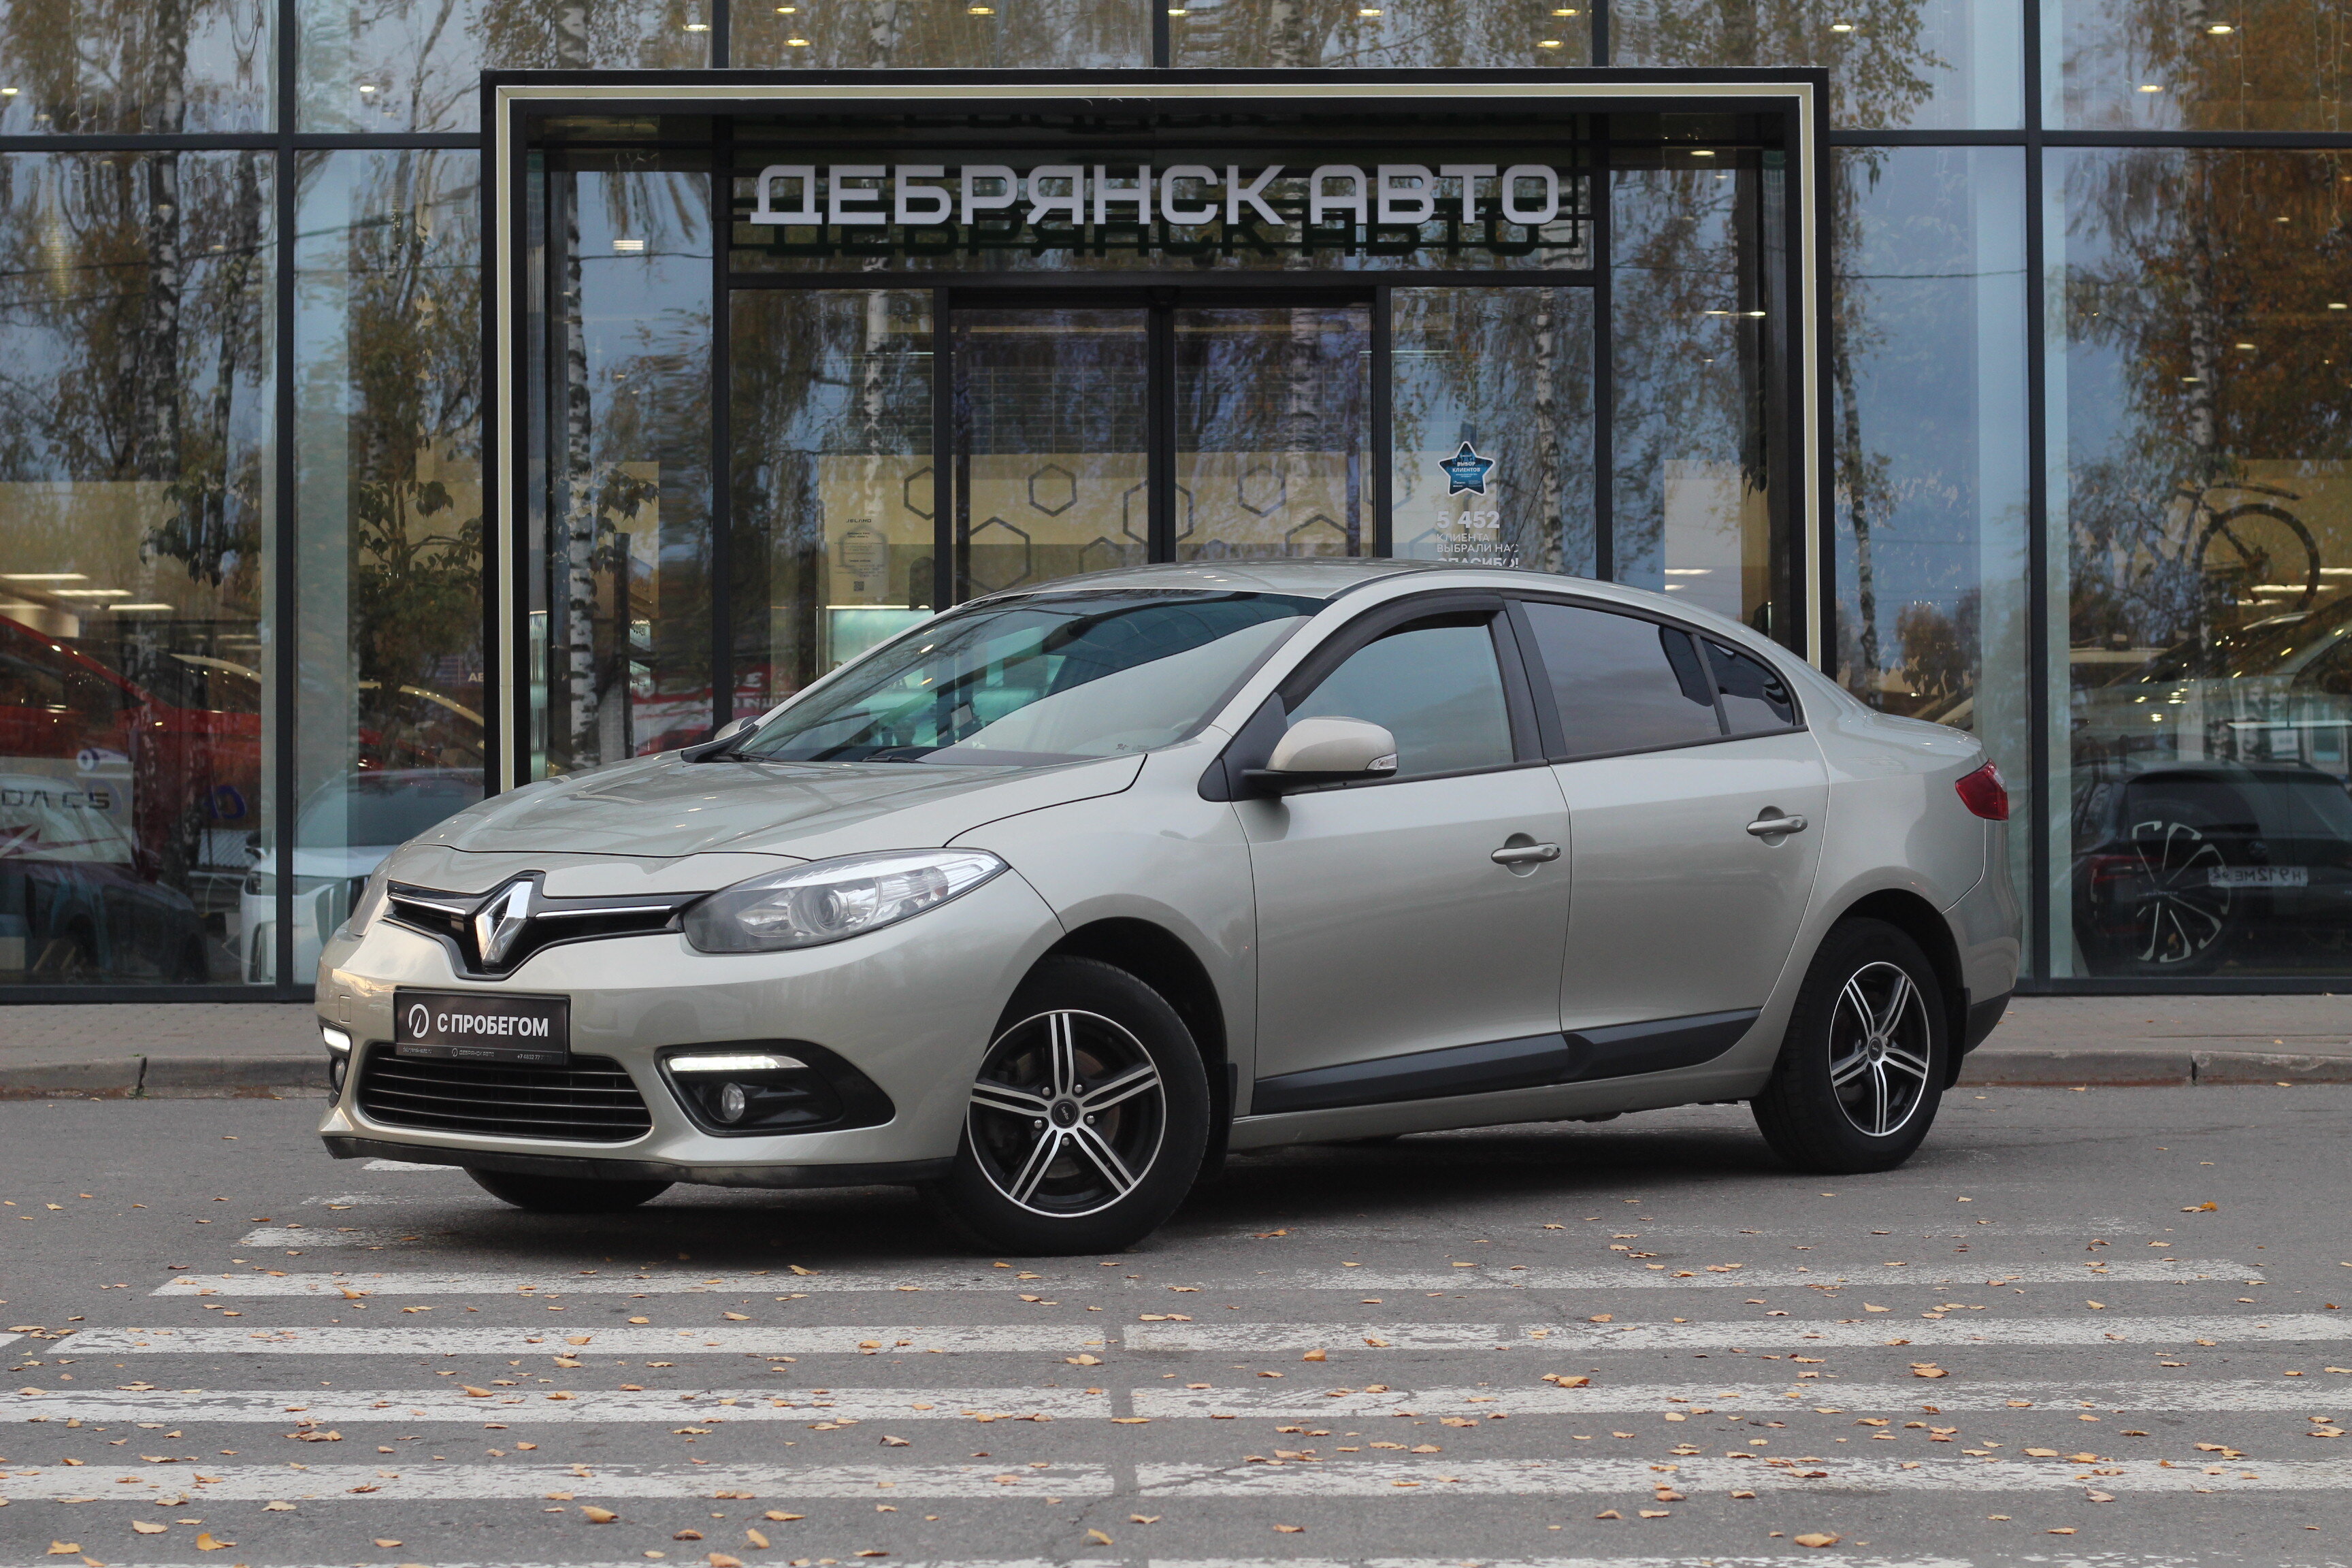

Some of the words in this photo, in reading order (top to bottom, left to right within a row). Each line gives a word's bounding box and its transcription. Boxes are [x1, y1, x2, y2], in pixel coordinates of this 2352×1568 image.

[750, 164, 1286, 226] ДЕБРЯНСК
[1310, 164, 1558, 226] АВТО
[1437, 511, 1450, 528] 5
[1457, 511, 1500, 529] 452
[1437, 533, 1490, 542] КЛИЕНТА
[1437, 544, 1492, 553] ВЫБРАЛИ
[1495, 544, 1519, 553] НАС
[437, 1013, 448, 1032] С
[451, 1014, 549, 1037] ПРОБЕГОМ
